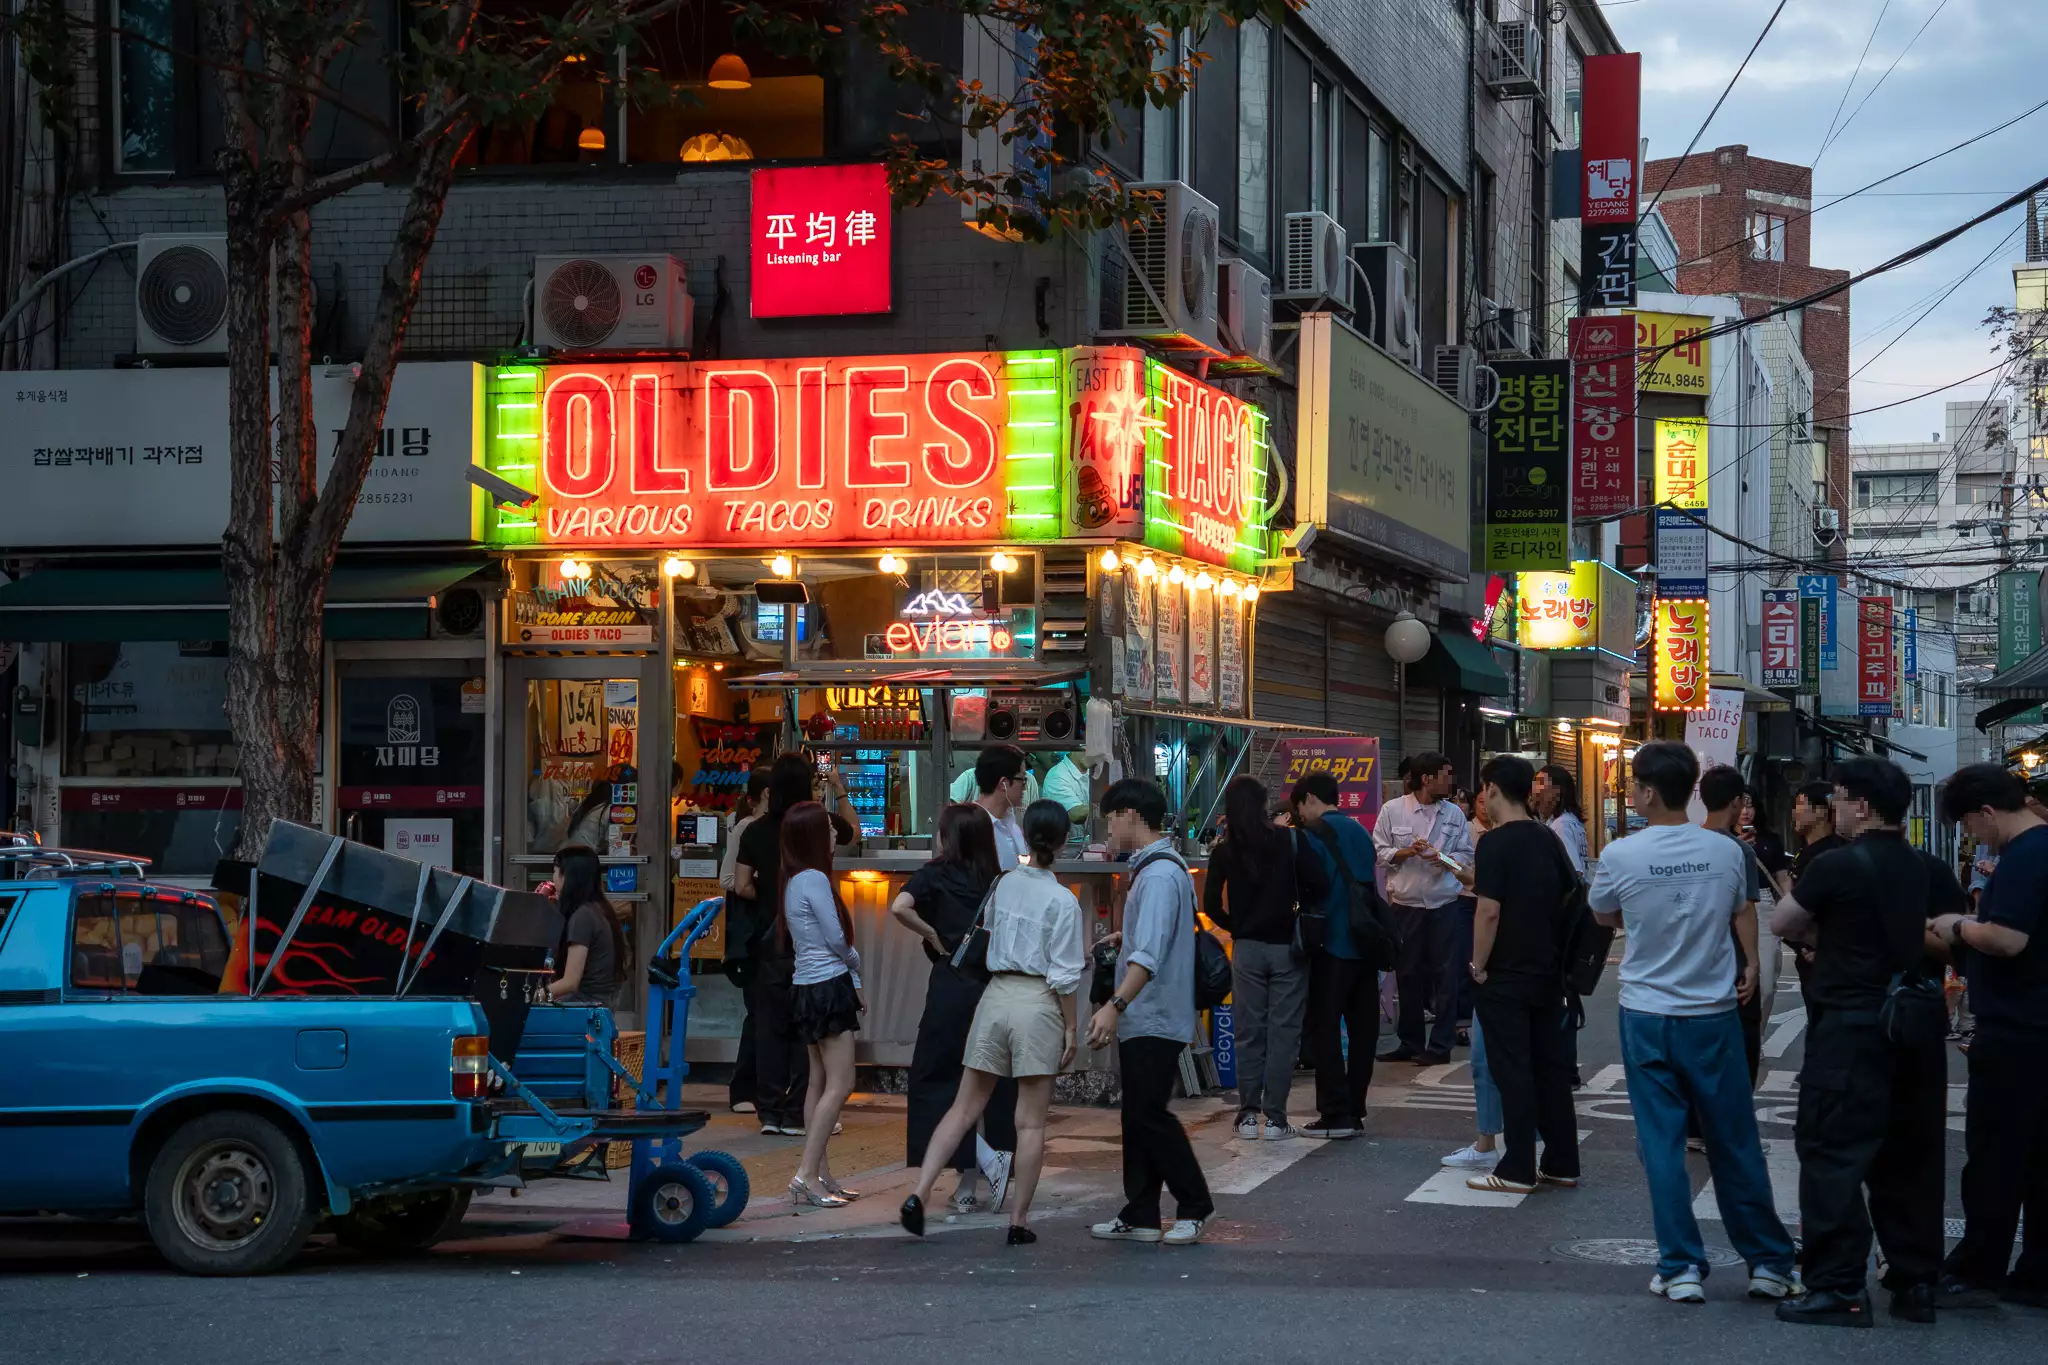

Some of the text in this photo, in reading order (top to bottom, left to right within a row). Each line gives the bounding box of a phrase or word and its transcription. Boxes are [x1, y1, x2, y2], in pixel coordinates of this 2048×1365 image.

[1588, 200, 1629, 208] YEDANG
[1588, 207, 1629, 217] 2277-9992
[765, 210, 877, 250] 平均律
[767, 251, 842, 266] Listening bar
[1597, 232, 1633, 306] 간판
[636, 293, 655, 306] LG
[1076, 367, 1109, 392] EAST
[16, 390, 68, 403] 휴게음식점
[1499, 374, 1564, 412] 명함
[543, 359, 996, 498] OLDIES
[1494, 415, 1564, 452] 전단
[33, 445, 203, 466] 찹쌀꽈배기 과자점
[1170, 375, 1254, 523] TACO
[1581, 447, 1600, 490] 카렌다
[1604, 446, 1621, 489] 인쇄사
[1666, 440, 1697, 499] 순대국
[547, 496, 994, 538] VARIOUS TACOS DRINKS
[1495, 509, 1559, 518] 02-2266-3917
[1493, 527, 1561, 539] 모든인쇄의 시작
[1492, 541, 1562, 560] 준디자인
[533, 578, 593, 604] THANK
[1543, 581, 1570, 596] 수향
[536, 610, 636, 626] COME AGAIN
[1520, 598, 1595, 621] 노래방
[551, 629, 622, 641] OLDIES TACO
[886, 614, 993, 653] evian
[1767, 604, 1796, 667] 스티카
[1667, 604, 1702, 687] 노래방
[1764, 669, 1797, 679] 영미사
[564, 692, 596, 726] USA
[608, 708, 637, 727] SNACK
[1687, 708, 1741, 726] OLDIES
[1698, 726, 1729, 740] TACO
[375, 746, 441, 766] 자미당
[1284, 757, 1376, 784] 진영광고
[612, 787, 637, 804] JCB
[1648, 861, 1711, 877] together
[299, 904, 359, 930] EAM
[1213, 1005, 1235, 1071] recycle
